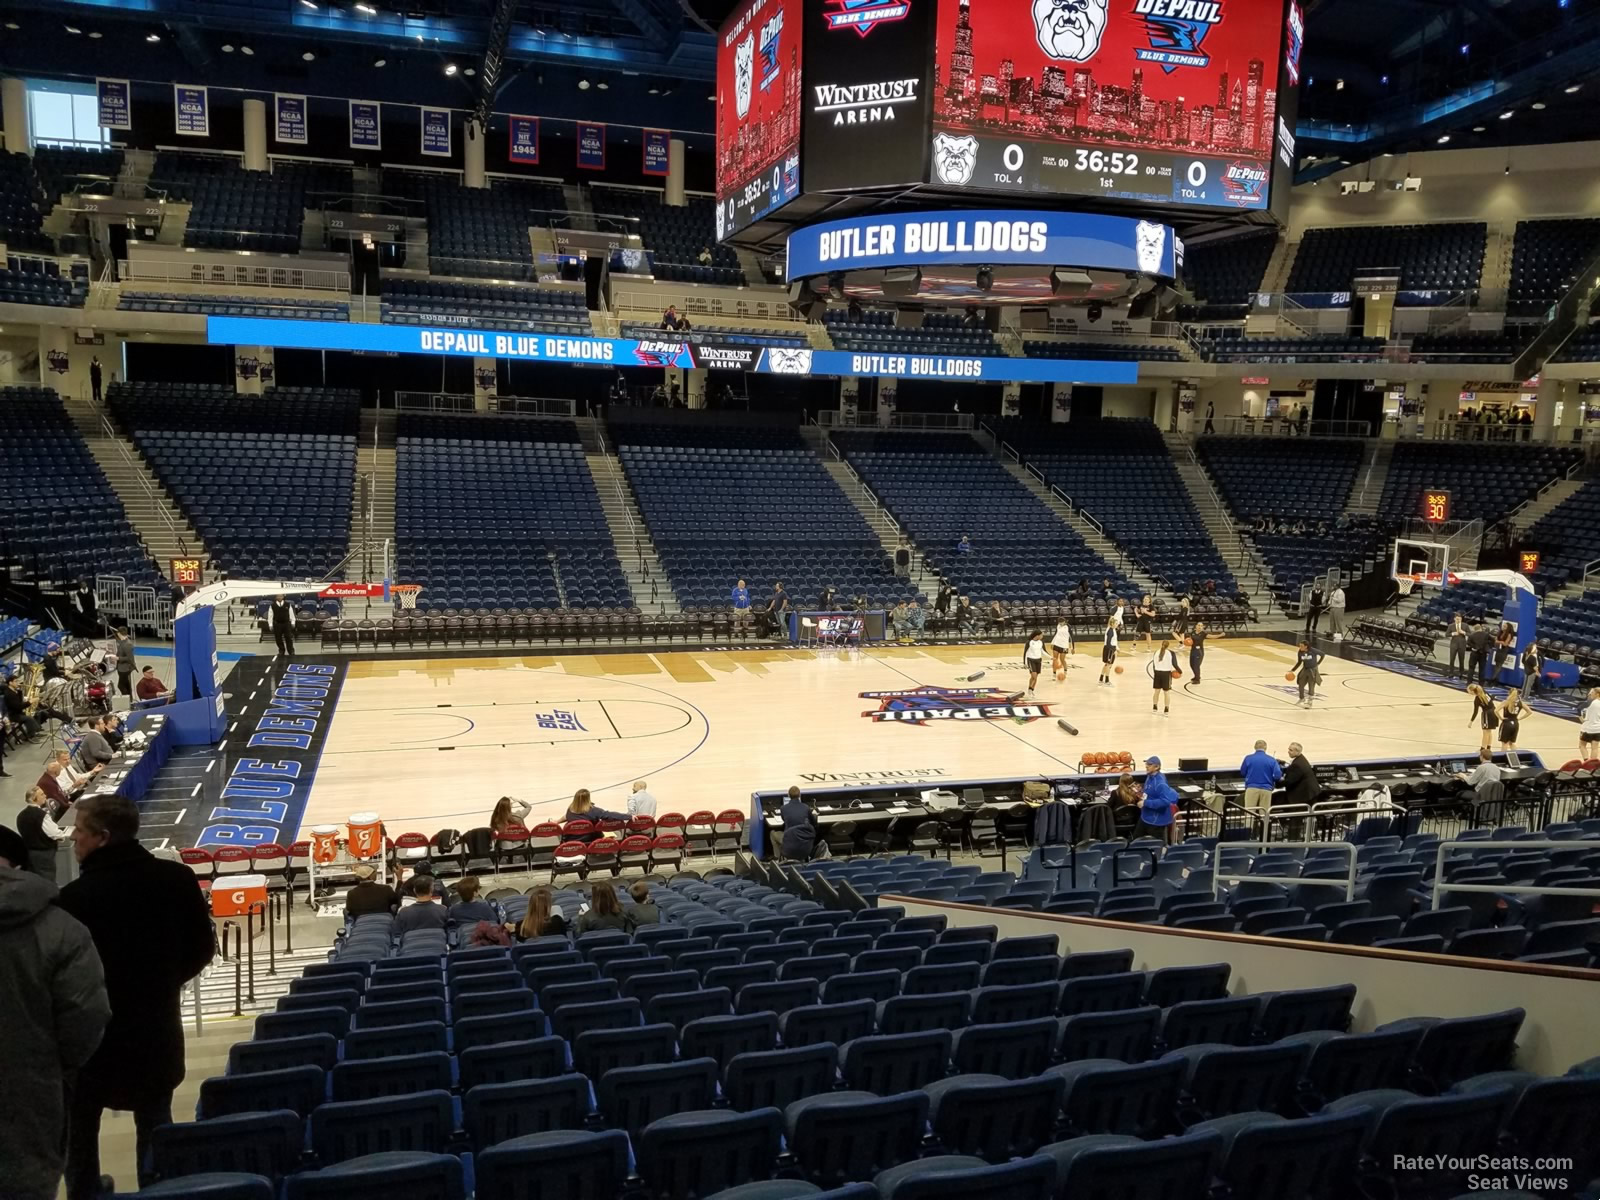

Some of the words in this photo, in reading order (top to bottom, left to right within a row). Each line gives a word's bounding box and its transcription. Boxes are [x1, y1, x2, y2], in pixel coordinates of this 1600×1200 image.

[836, 14, 861, 25] BLUE
[863, 6, 904, 21] DEMONS
[1140, 51, 1166, 62] BLUE
[1168, 55, 1206, 66] DEMONS
[814, 78, 919, 106] WINTRUST
[180, 103, 203, 112] NCAA
[280, 112, 302, 120] NCAA
[833, 105, 896, 126] ARENA
[355, 118, 375, 126] NCAA
[426, 125, 446, 133] NCAA
[582, 139, 601, 147] NCAA
[513, 145, 536, 154] 1945
[647, 146, 666, 154] NCAA
[1003, 144, 1024, 171] 0
[1074, 149, 1139, 175] 36:52
[1058, 159, 1069, 168] 00
[1145, 166, 1156, 175] 00
[1187, 161, 1207, 187] 0
[994, 173, 1012, 183] TOL
[1016, 176, 1023, 184] 4
[1100, 177, 1114, 187] 1st
[1181, 189, 1197, 198] TOL
[1200, 191, 1206, 199] 4
[557, 237, 569, 245] 224
[819, 224, 896, 262] BUTLER
[904, 220, 1048, 253] BULLDOGS
[420, 331, 489, 354] DEPAUL
[496, 335, 540, 357] BLUE
[545, 338, 613, 360] DEMONS
[699, 346, 752, 360] WINTRUST
[710, 361, 741, 369] ARENA
[852, 355, 906, 375] BUTLER
[911, 358, 982, 376] BULLDOGS
[1428, 495, 1446, 504] 36:52
[1429, 505, 1444, 520] 30
[174, 561, 199, 569] 36:52
[1525, 562, 1533, 570] 30
[180, 570, 194, 581] 30
[247, 664, 337, 750] DEMONS
[535, 713, 558, 729] BIG
[553, 709, 578, 731] EAST
[797, 768, 946, 782] WINTRUST
[194, 758, 302, 850] BLUE
[358, 830, 370, 840] G
[322, 839, 331, 848] G
[232, 891, 245, 904] G
